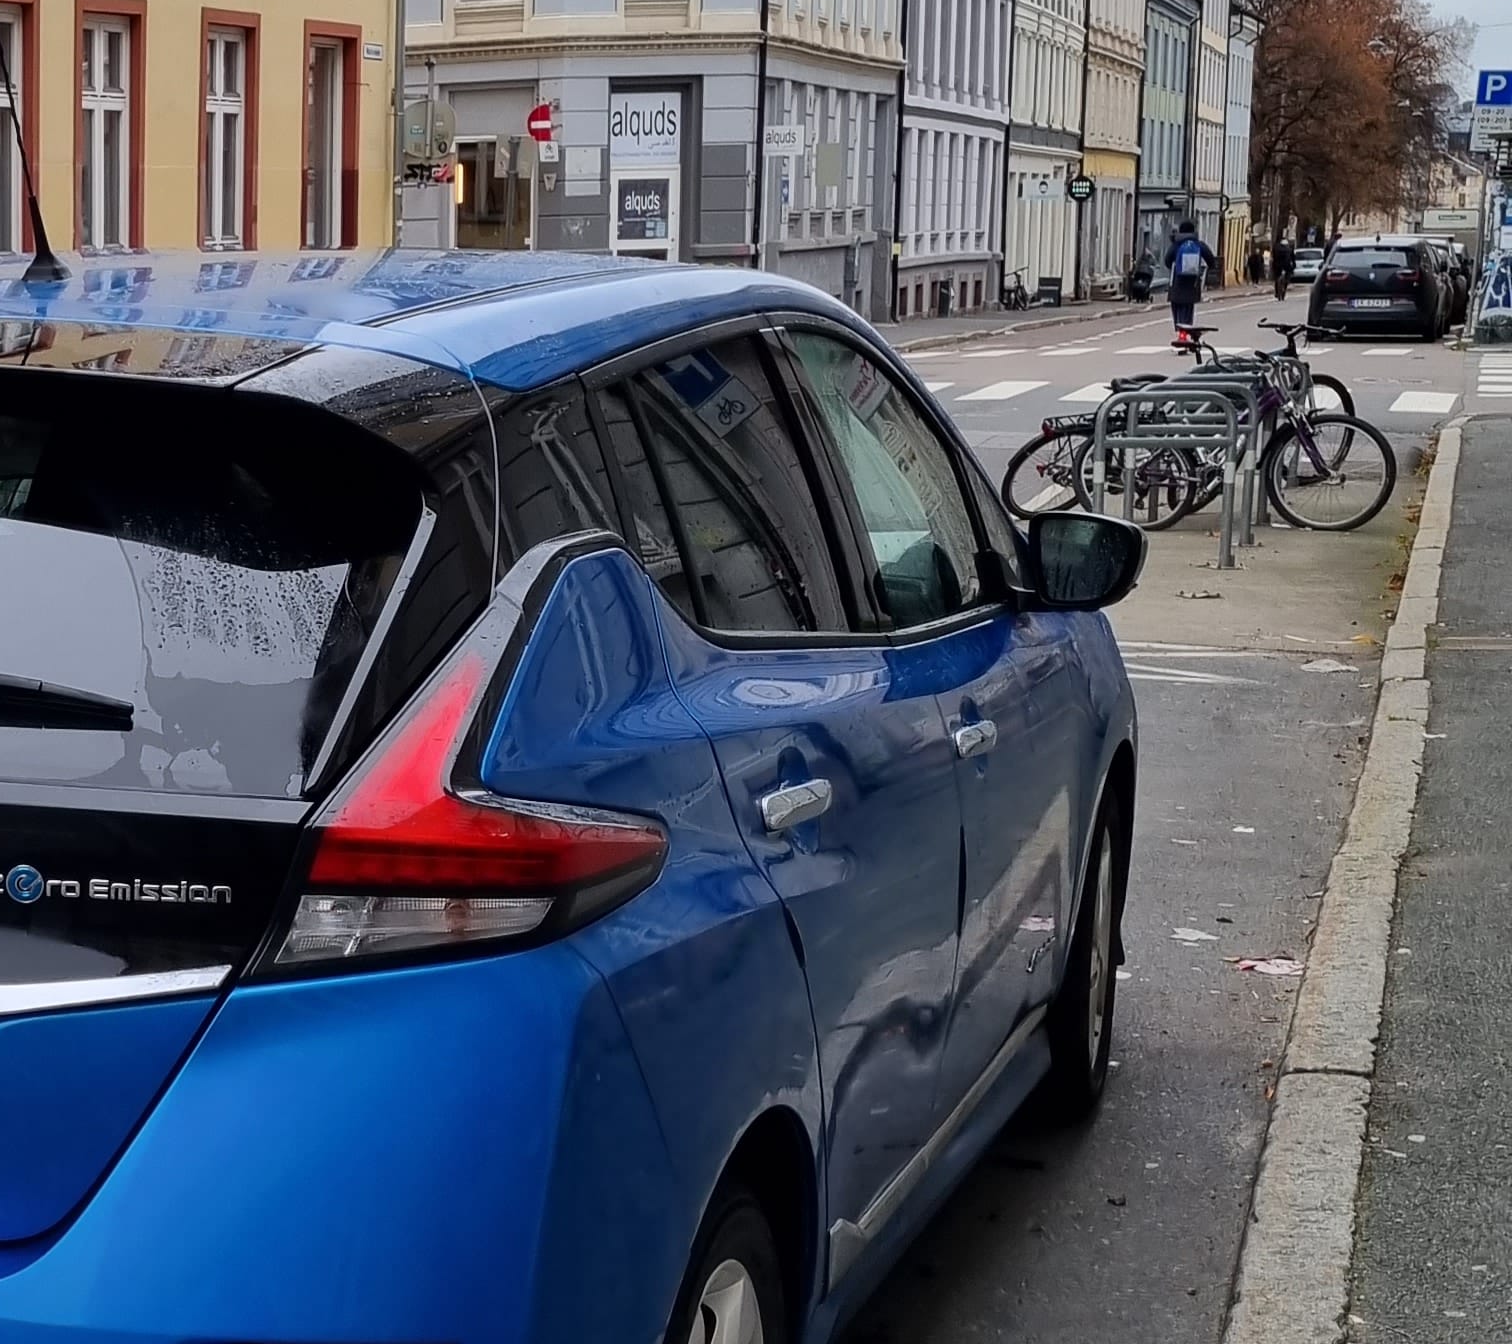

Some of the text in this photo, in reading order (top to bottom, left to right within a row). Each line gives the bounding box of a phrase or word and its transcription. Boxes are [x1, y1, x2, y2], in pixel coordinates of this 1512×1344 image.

[1485, 74, 1507, 102] P
[611, 100, 677, 146] alquds
[765, 129, 797, 147] alquds
[625, 190, 660, 215] alquds
[89, 879, 232, 903] Emission
